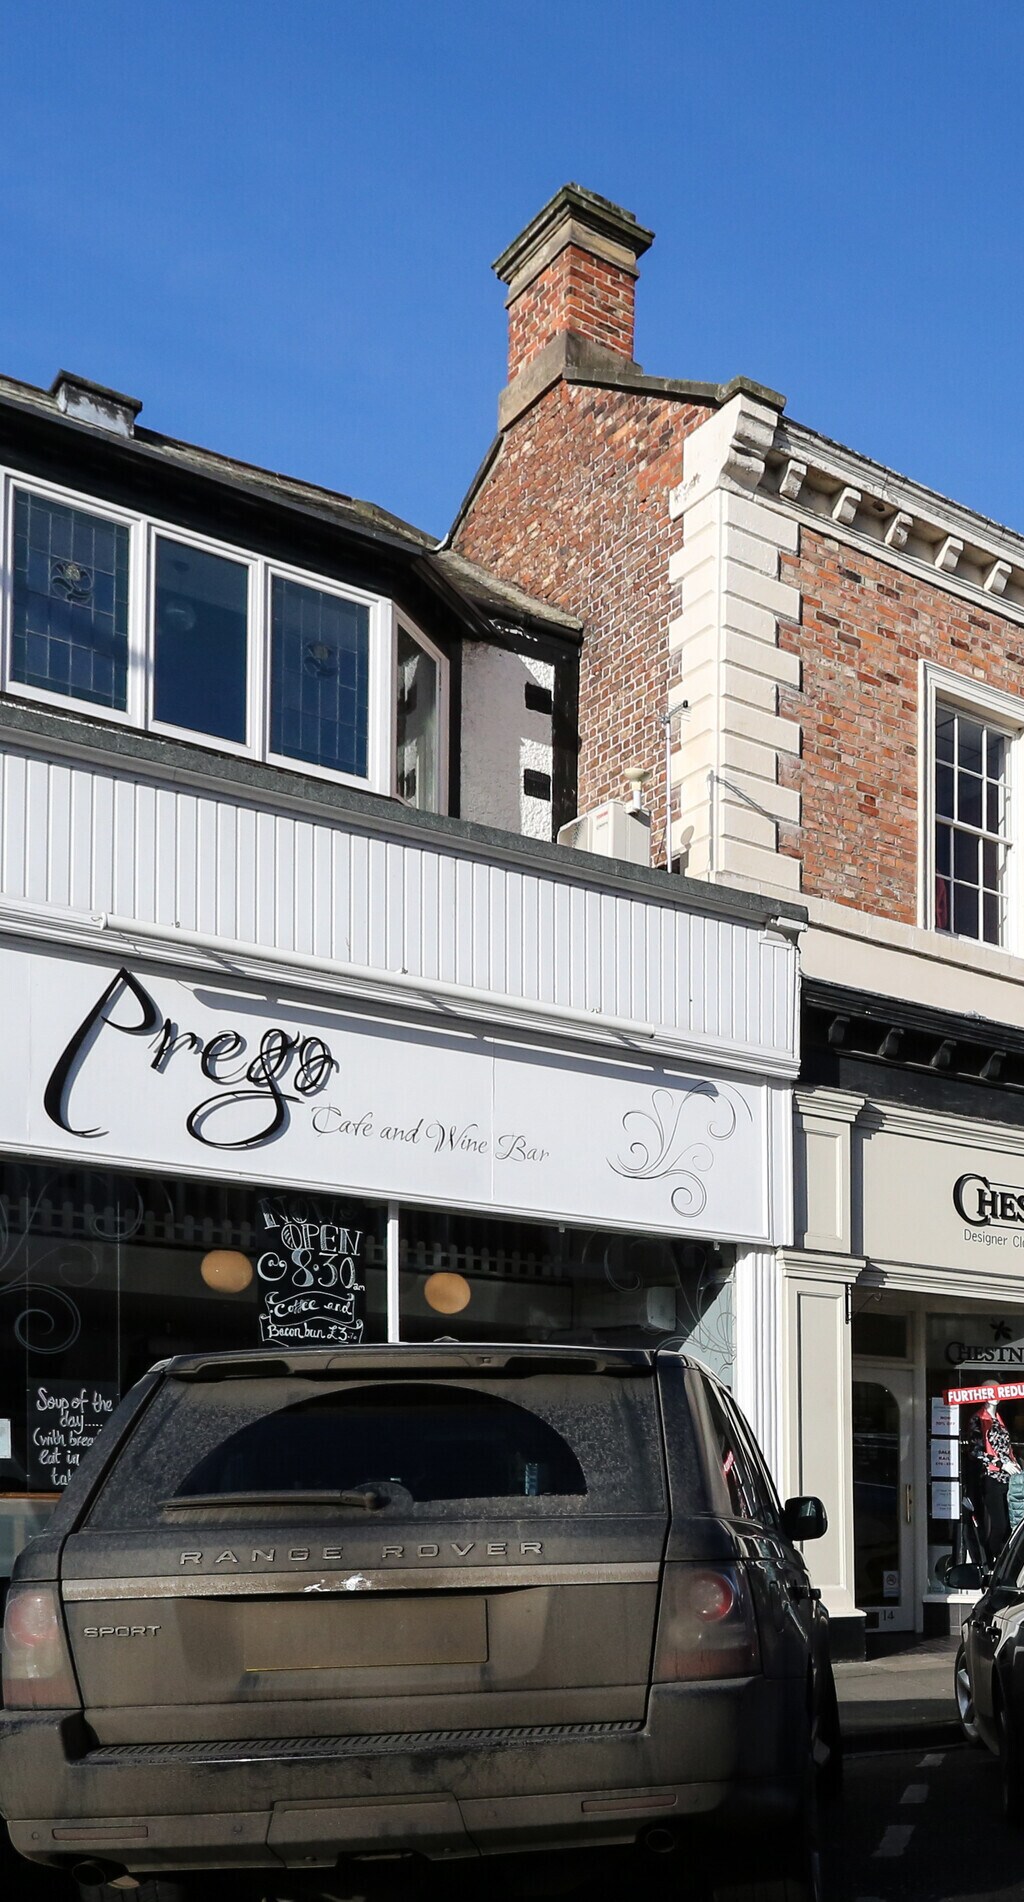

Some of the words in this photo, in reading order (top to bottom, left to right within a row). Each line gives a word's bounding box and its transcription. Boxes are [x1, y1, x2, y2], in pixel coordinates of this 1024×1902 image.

[44, 967, 337, 1147] Prego
[311, 1102, 373, 1137] Cafe
[379, 1118, 424, 1145] and
[425, 1119, 488, 1154] Wine
[495, 1131, 550, 1162] Bar
[281, 1223, 364, 1257] OPEN
[963, 1228, 1008, 1246] Designer
[267, 1324, 304, 1339] Bacon
[304, 1322, 326, 1339] bun
[35, 1387, 70, 1416] Soup
[71, 1388, 89, 1413] of
[92, 1390, 114, 1413] the
[947, 1385, 995, 1403] FURTHER
[69, 1429, 101, 1447] brea
[179, 1546, 343, 1565] RANGE
[382, 1541, 544, 1559] ROVER
[883, 1609, 895, 1621] 14
[83, 1624, 161, 1638] SPORT
